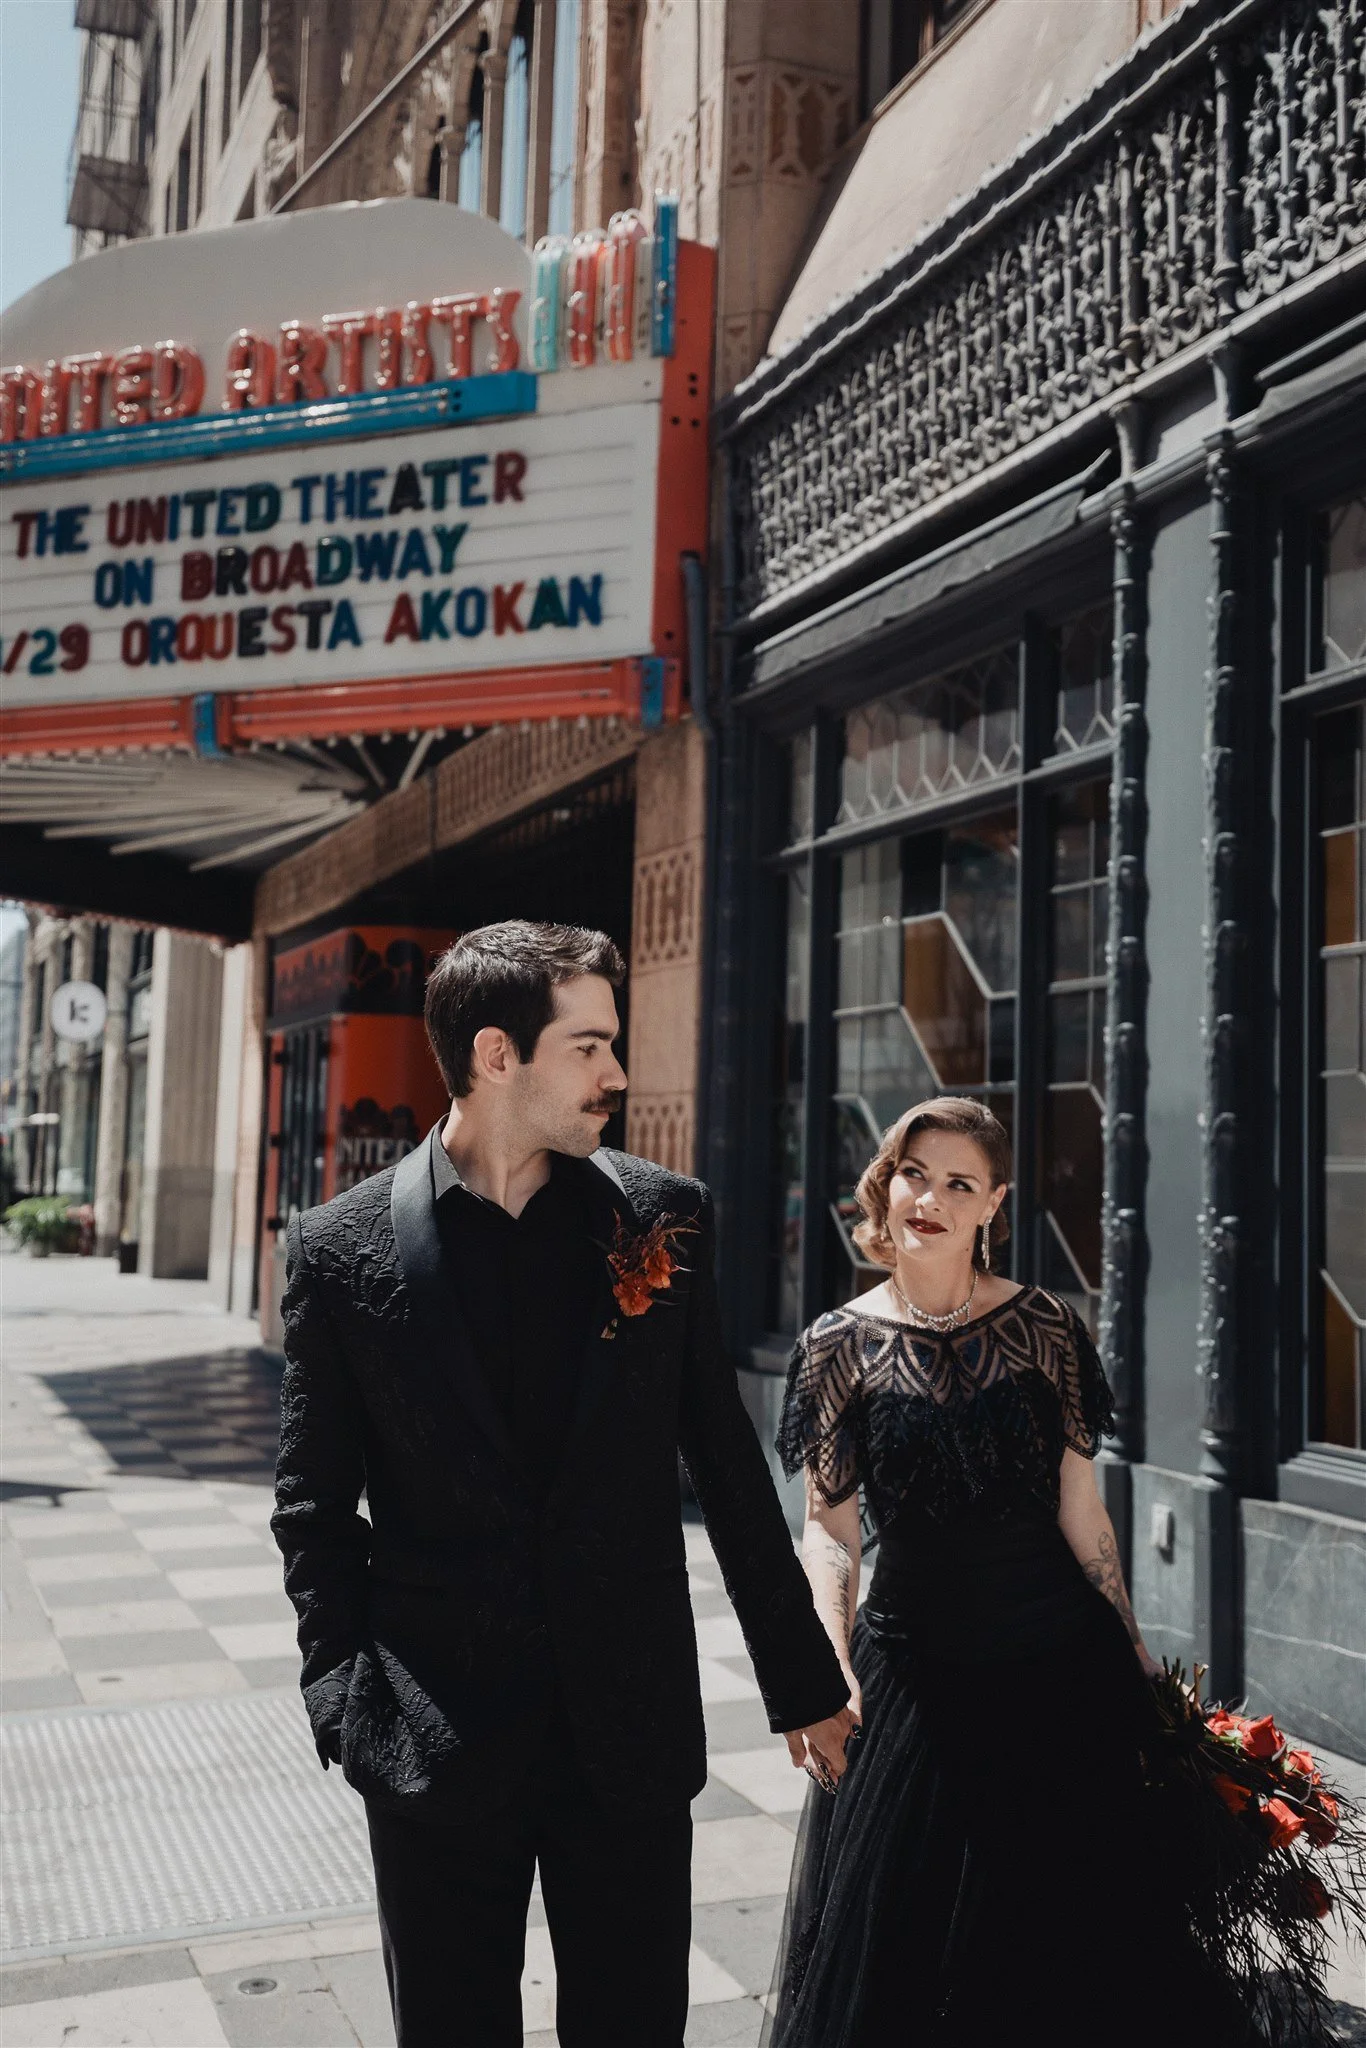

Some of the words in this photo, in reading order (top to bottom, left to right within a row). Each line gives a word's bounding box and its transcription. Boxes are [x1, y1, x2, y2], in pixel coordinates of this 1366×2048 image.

[223, 289, 521, 409] ARTISTS
[12, 505, 91, 558] THE
[107, 483, 282, 547] UNITED
[291, 451, 527, 525] THEATER
[94, 557, 154, 608] ON
[180, 522, 468, 602] BROADWAY
[0, 623, 90, 675] /29
[121, 599, 361, 667] ORQUESTA
[384, 573, 603, 644] AKOKAN
